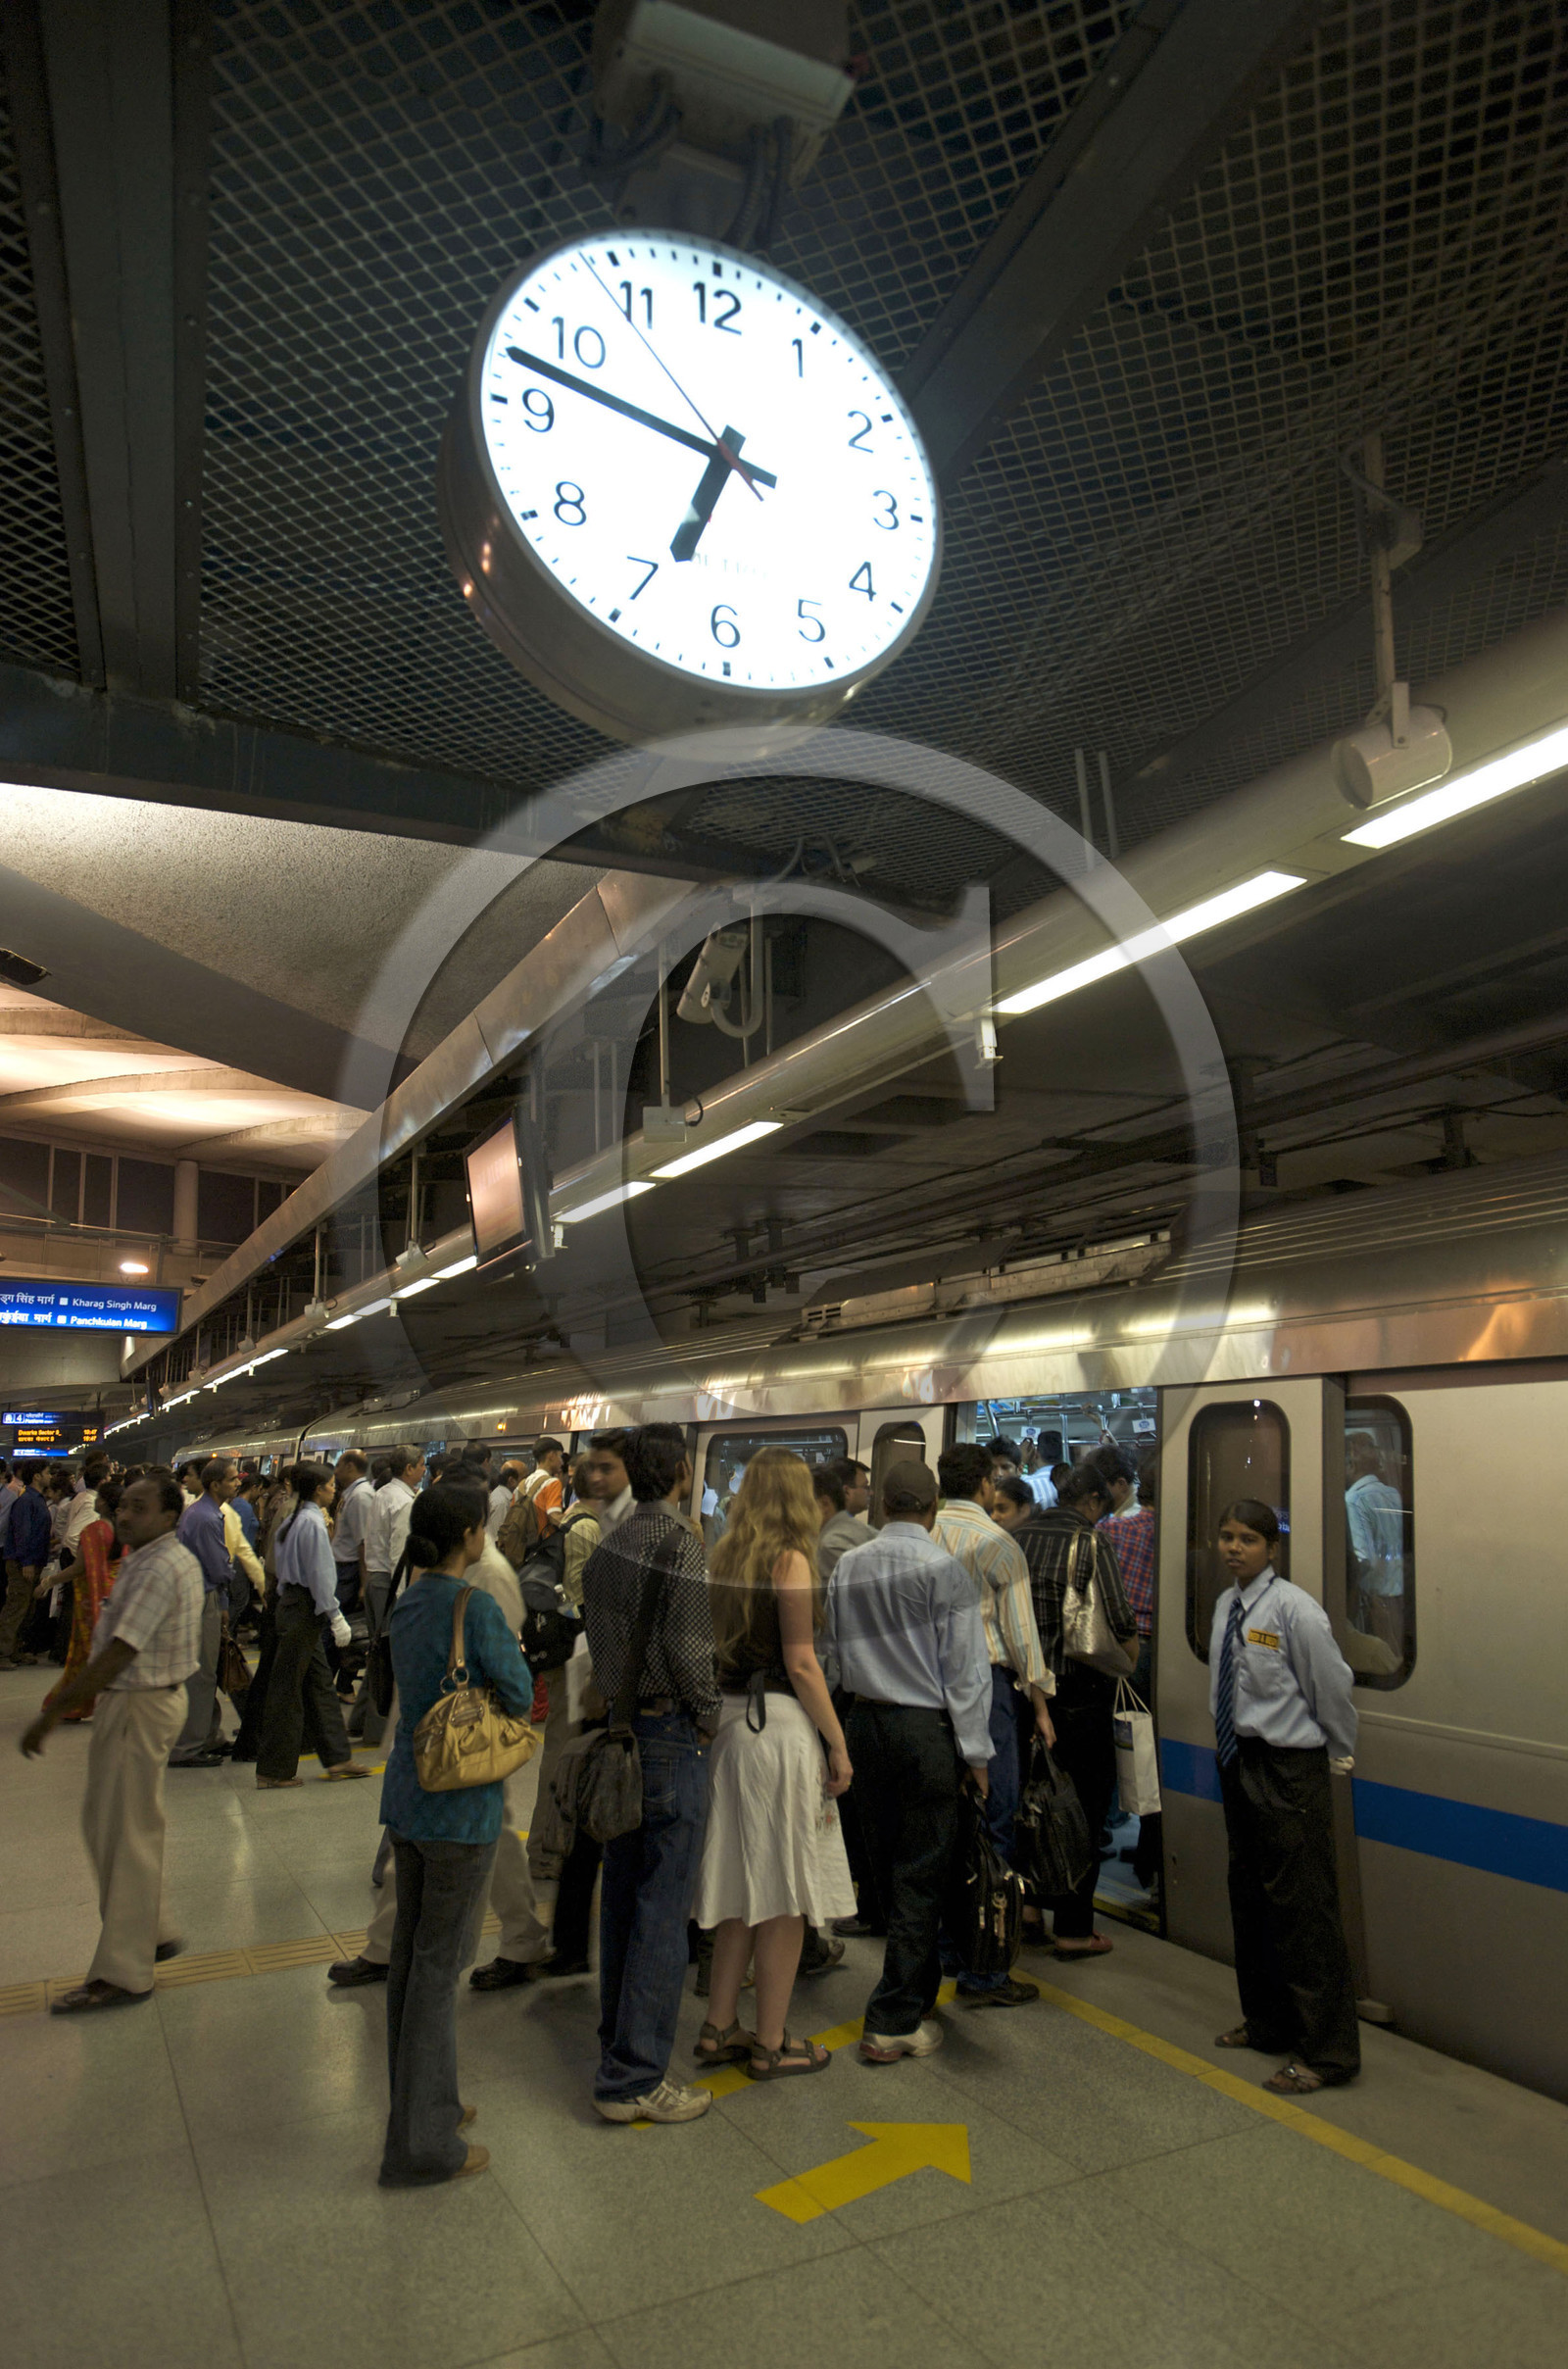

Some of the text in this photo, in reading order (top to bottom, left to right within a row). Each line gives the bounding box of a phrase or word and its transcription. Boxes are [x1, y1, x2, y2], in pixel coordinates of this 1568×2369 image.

[620, 281, 653, 329] 11
[693, 281, 742, 335] 12
[552, 317, 606, 369] 10
[792, 338, 804, 377] 1
[521, 388, 555, 432] 9
[848, 411, 874, 453] 2
[554, 481, 587, 526] 8
[873, 490, 899, 530] 3
[626, 556, 659, 600] 7
[849, 561, 877, 602] 4
[710, 605, 741, 648] 6
[798, 599, 826, 642] 5
[72, 1298, 157, 1312] Kharag Singh Marg
[123, 1318, 148, 1330] Marg
